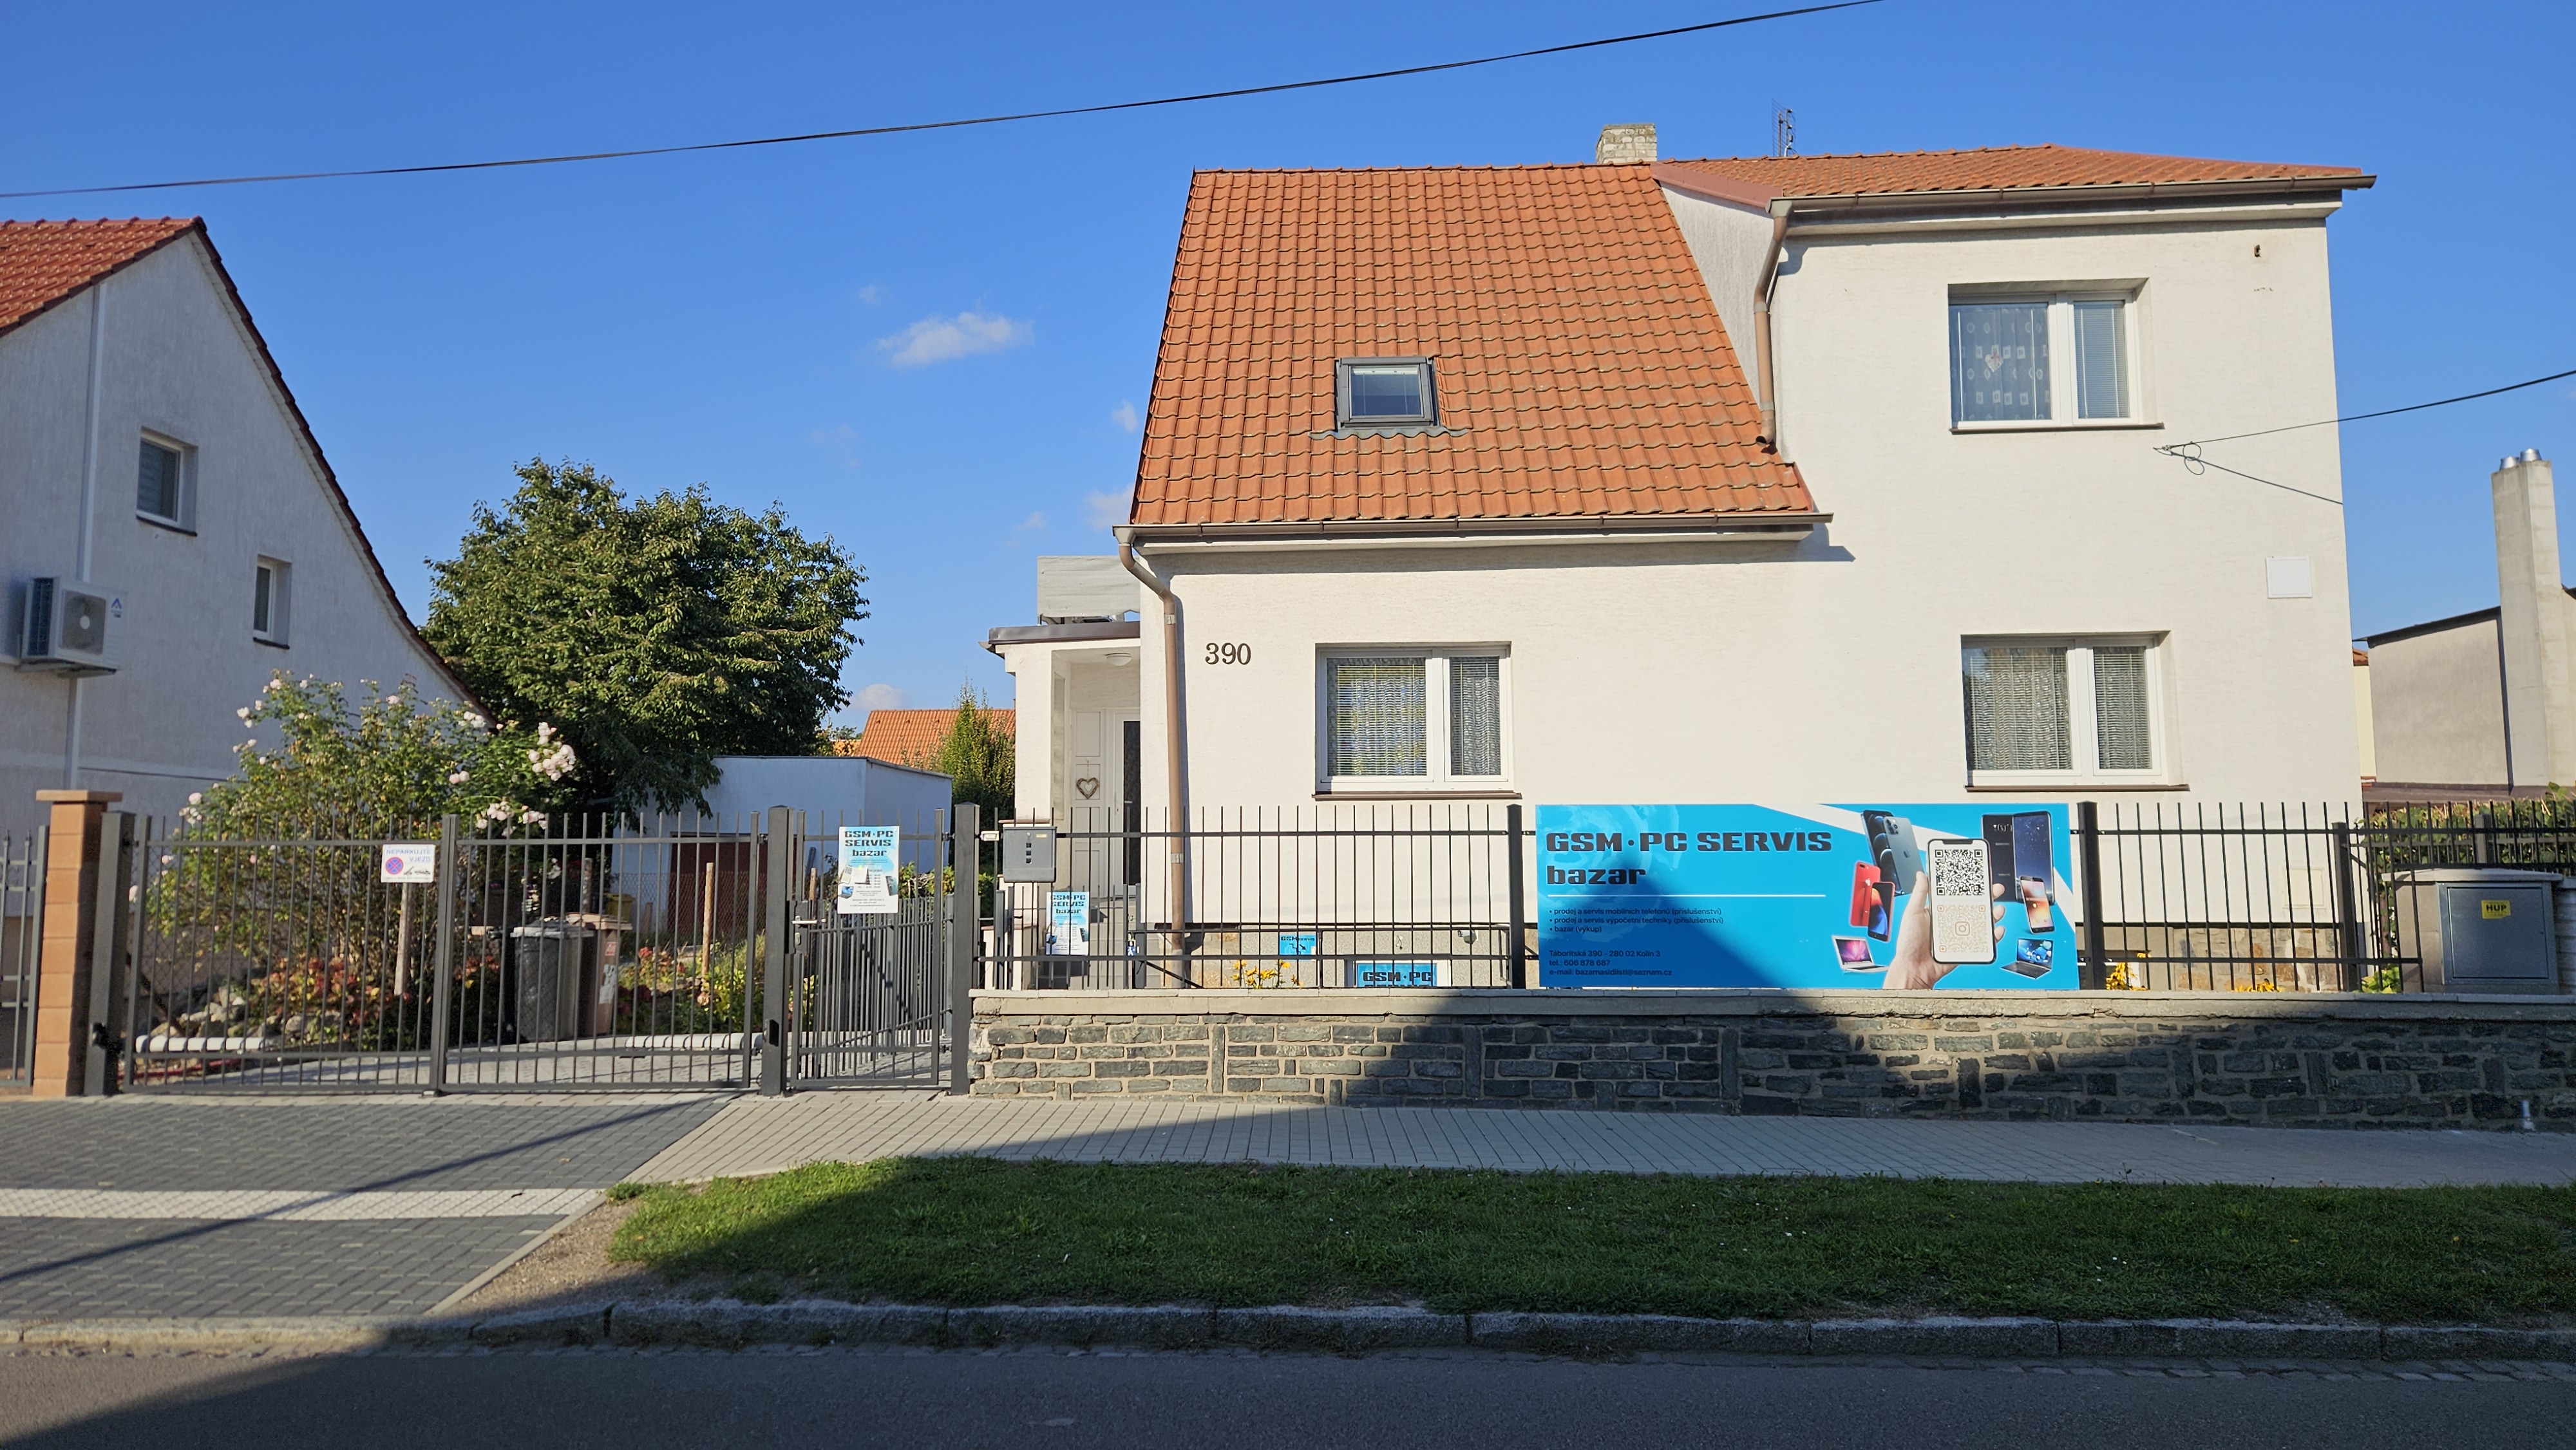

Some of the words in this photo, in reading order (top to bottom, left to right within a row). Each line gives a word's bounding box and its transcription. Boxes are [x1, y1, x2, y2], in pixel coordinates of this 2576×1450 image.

[1205, 643, 1251, 665] 390
[1696, 832, 1832, 852] SERVIS
[1547, 865, 1646, 885] bazar
[1606, 916, 1641, 925] výpočetní
